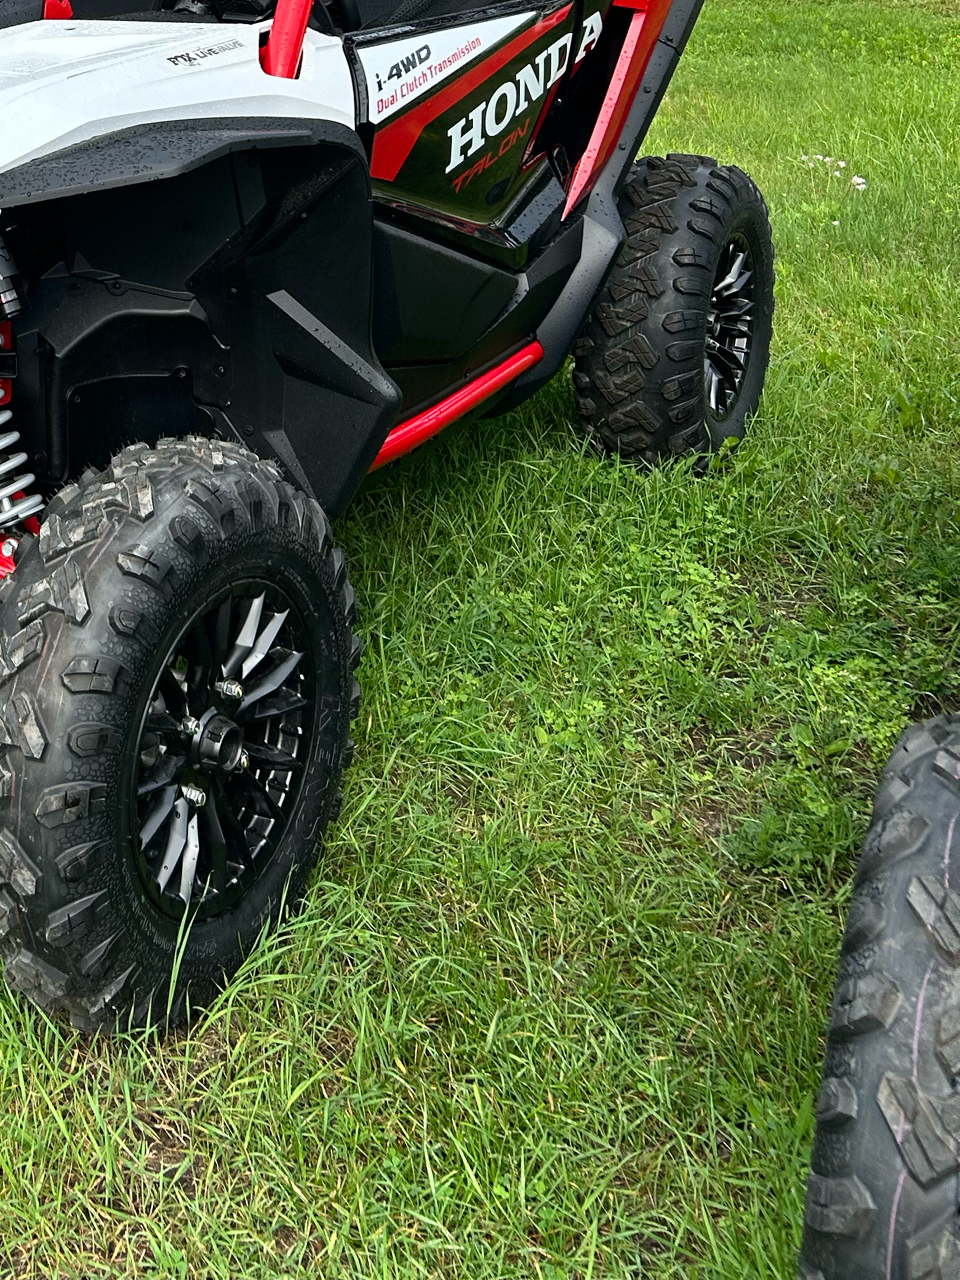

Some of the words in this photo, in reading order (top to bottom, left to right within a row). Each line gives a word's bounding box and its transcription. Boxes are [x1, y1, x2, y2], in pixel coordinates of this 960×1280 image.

[375, 44, 431, 93] i-4WD
[376, 90, 398, 114] Dual
[400, 71, 428, 98] Clutch
[427, 36, 482, 79] Transmission
[445, 11, 603, 174] HONDA
[452, 117, 531, 194] TALON
